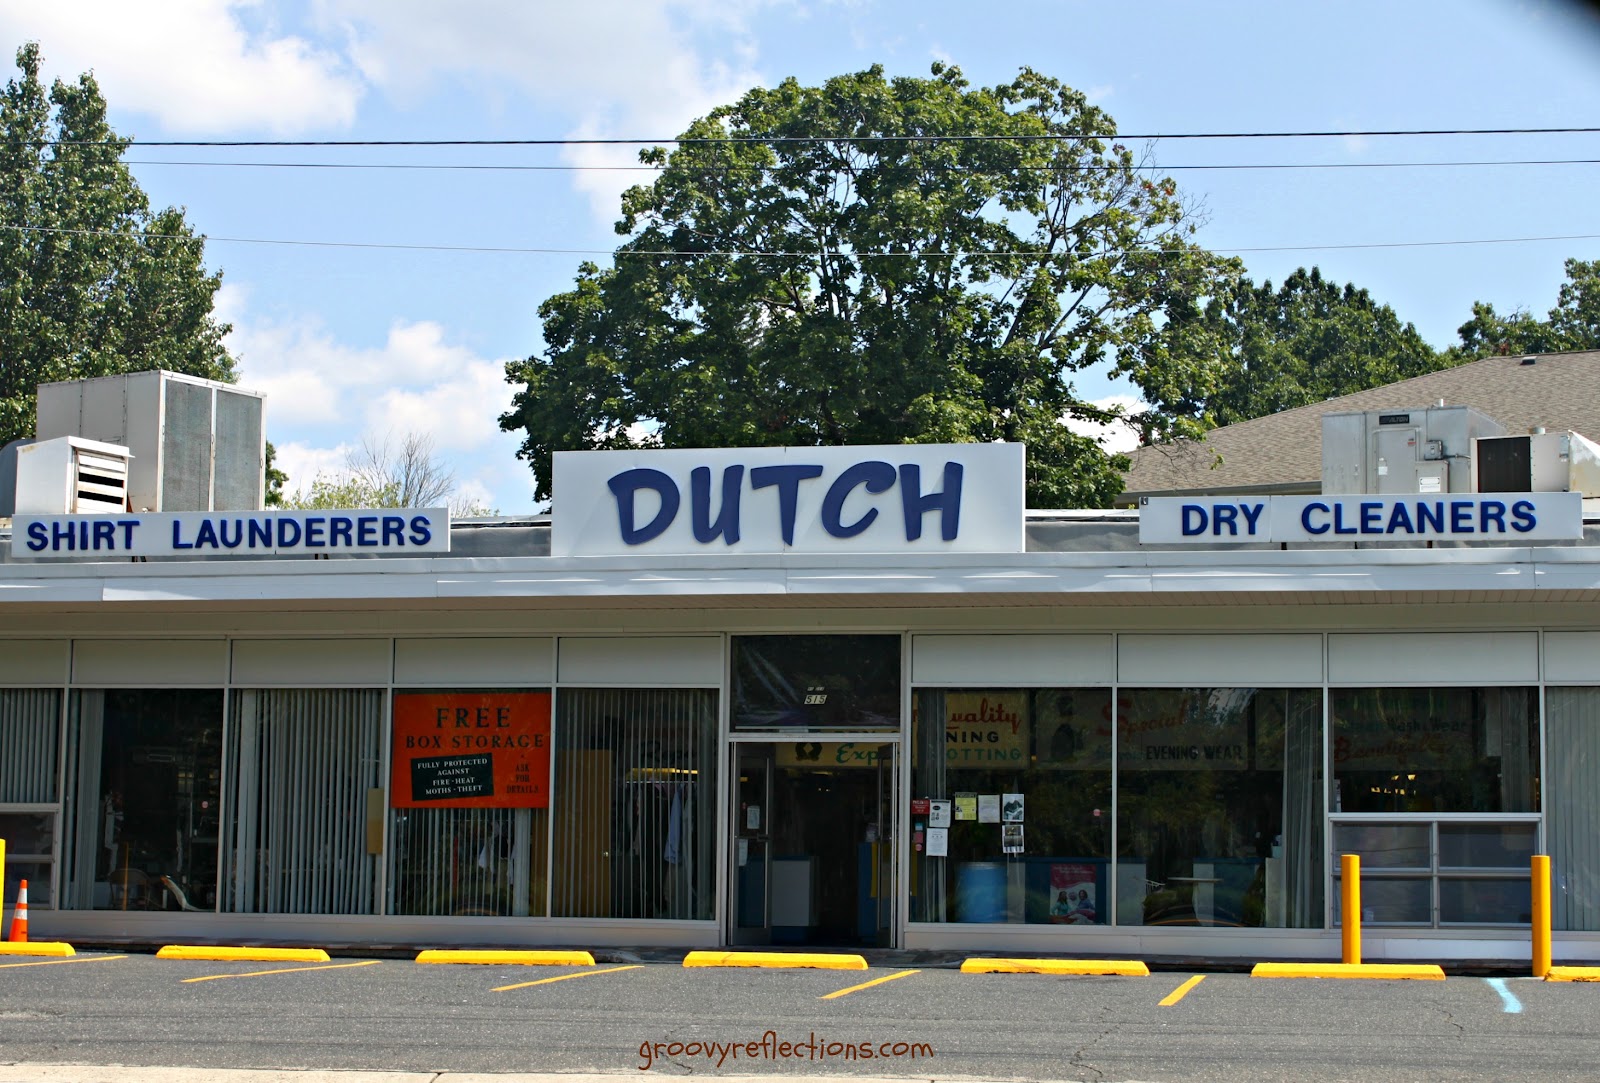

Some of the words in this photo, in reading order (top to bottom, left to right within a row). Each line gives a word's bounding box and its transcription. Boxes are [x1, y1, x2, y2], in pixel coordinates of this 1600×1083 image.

[607, 461, 964, 546] DUTCH
[1181, 504, 1264, 536] DRY
[1301, 500, 1537, 534] CLEANERS
[26, 520, 140, 551] SHIRT
[172, 515, 432, 550] LAUNDERERS
[806, 695, 826, 704] 515
[436, 707, 511, 729] FREE
[406, 735, 441, 748] BOX
[452, 734, 543, 748] STORAGE
[836, 743, 880, 766] Exp
[1146, 745, 1199, 760] EVENING
[1203, 744, 1243, 760] WEAR
[417, 761, 440, 770] FULLY
[444, 758, 488, 767] PROTECTED
[516, 763, 530, 773] ASK
[437, 767, 470, 776] AGAINST
[433, 778, 450, 786] FIRE
[516, 774, 530, 783] FOR
[425, 787, 451, 795] MOTHS
[456, 785, 483, 793] THEFT
[506, 784, 539, 794] DETAILS
